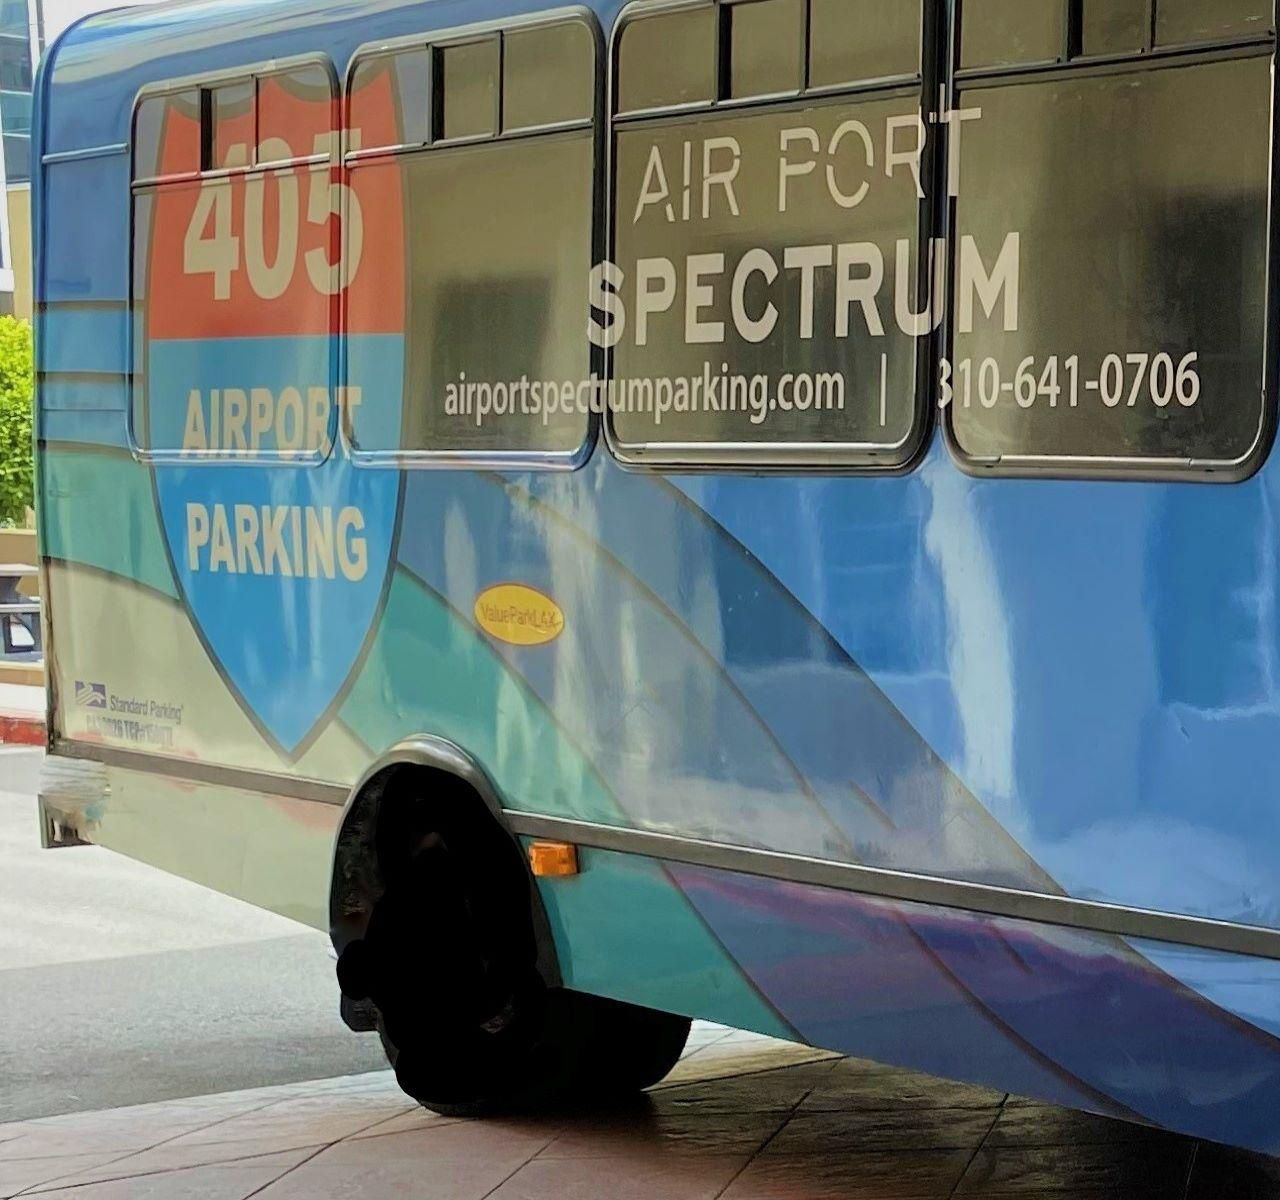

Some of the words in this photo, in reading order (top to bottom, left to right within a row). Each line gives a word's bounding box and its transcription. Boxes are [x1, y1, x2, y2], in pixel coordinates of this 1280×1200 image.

[184, 128, 363, 300] 405
[586, 231, 1020, 349] SPECTRUM
[938, 351, 1200, 409] 310-641-0706
[180, 386, 362, 459] AIRPORT
[187, 503, 368, 581] PARKING
[110, 695, 148, 716] Standard
[150, 701, 182, 724] Parking
